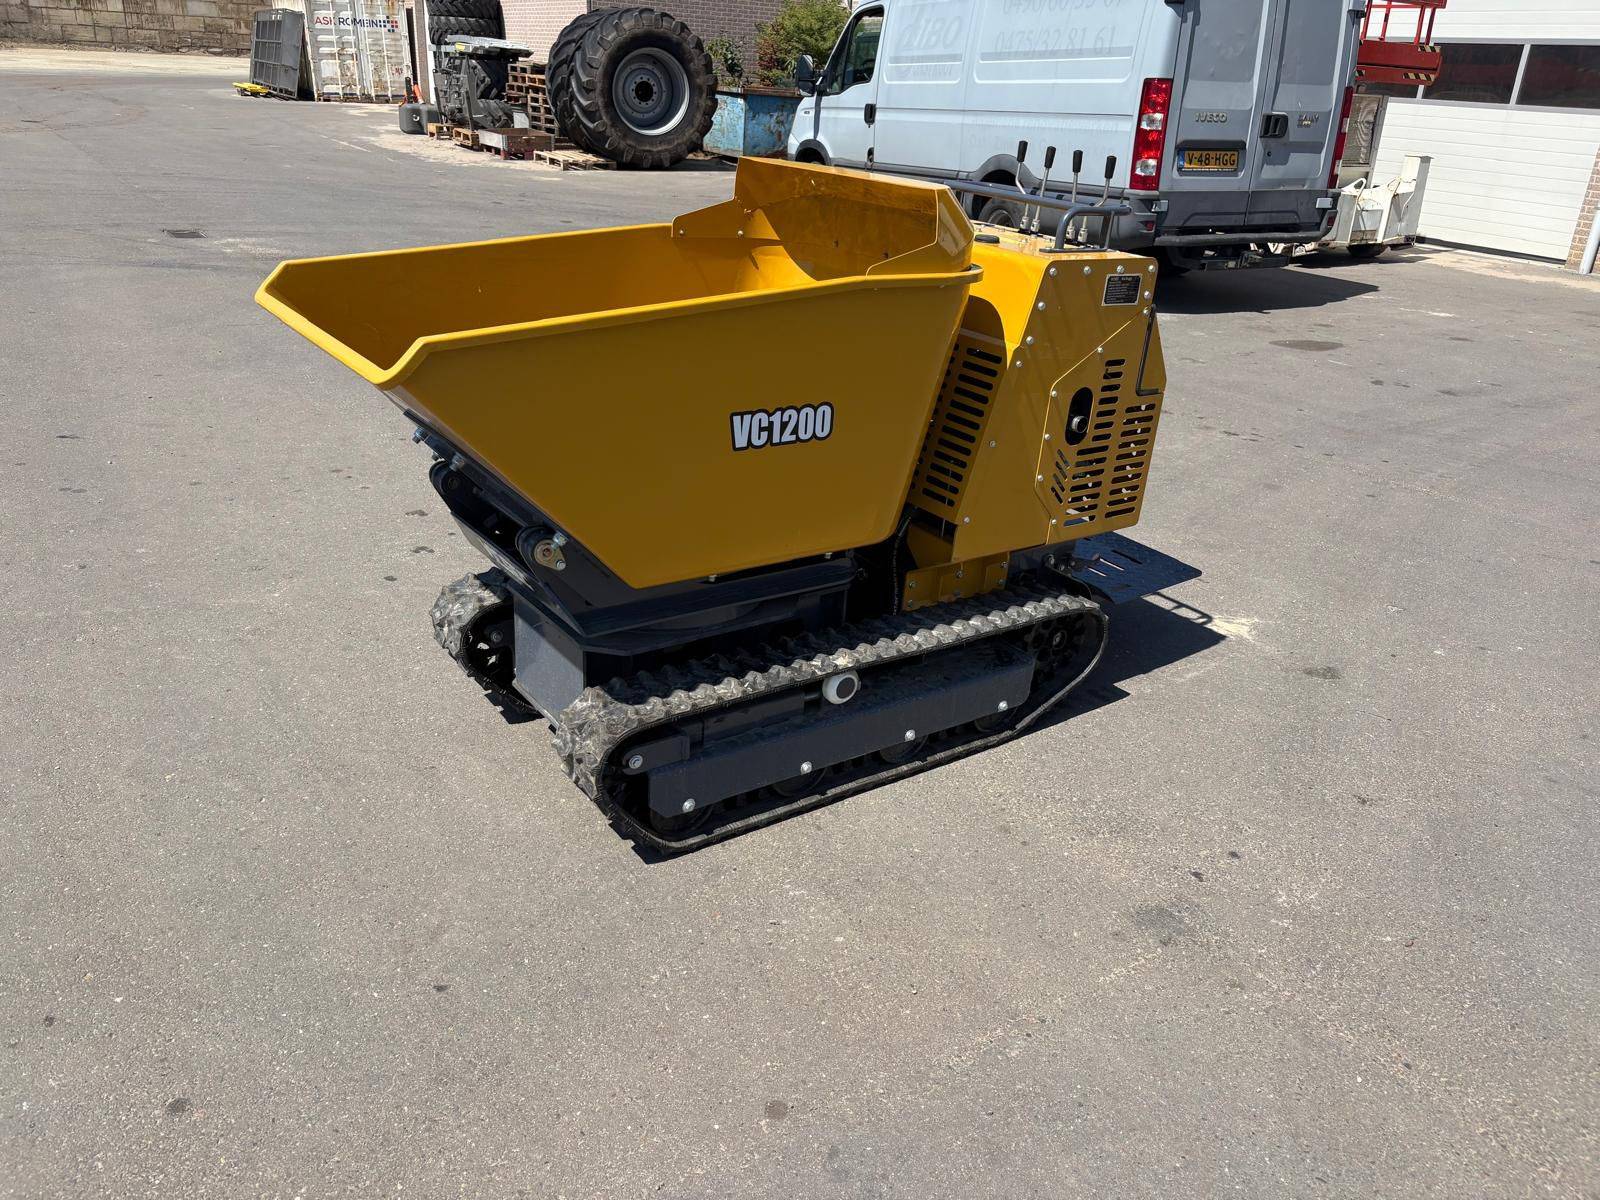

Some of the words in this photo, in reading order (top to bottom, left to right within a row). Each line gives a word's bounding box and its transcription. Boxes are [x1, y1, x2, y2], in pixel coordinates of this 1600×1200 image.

[315, 16, 336, 26] ASK
[338, 17, 379, 28] ROMEIN
[1194, 112, 1228, 123] IVECO
[1187, 152, 1236, 166] V-48-HGG
[730, 402, 835, 451] VC1200
